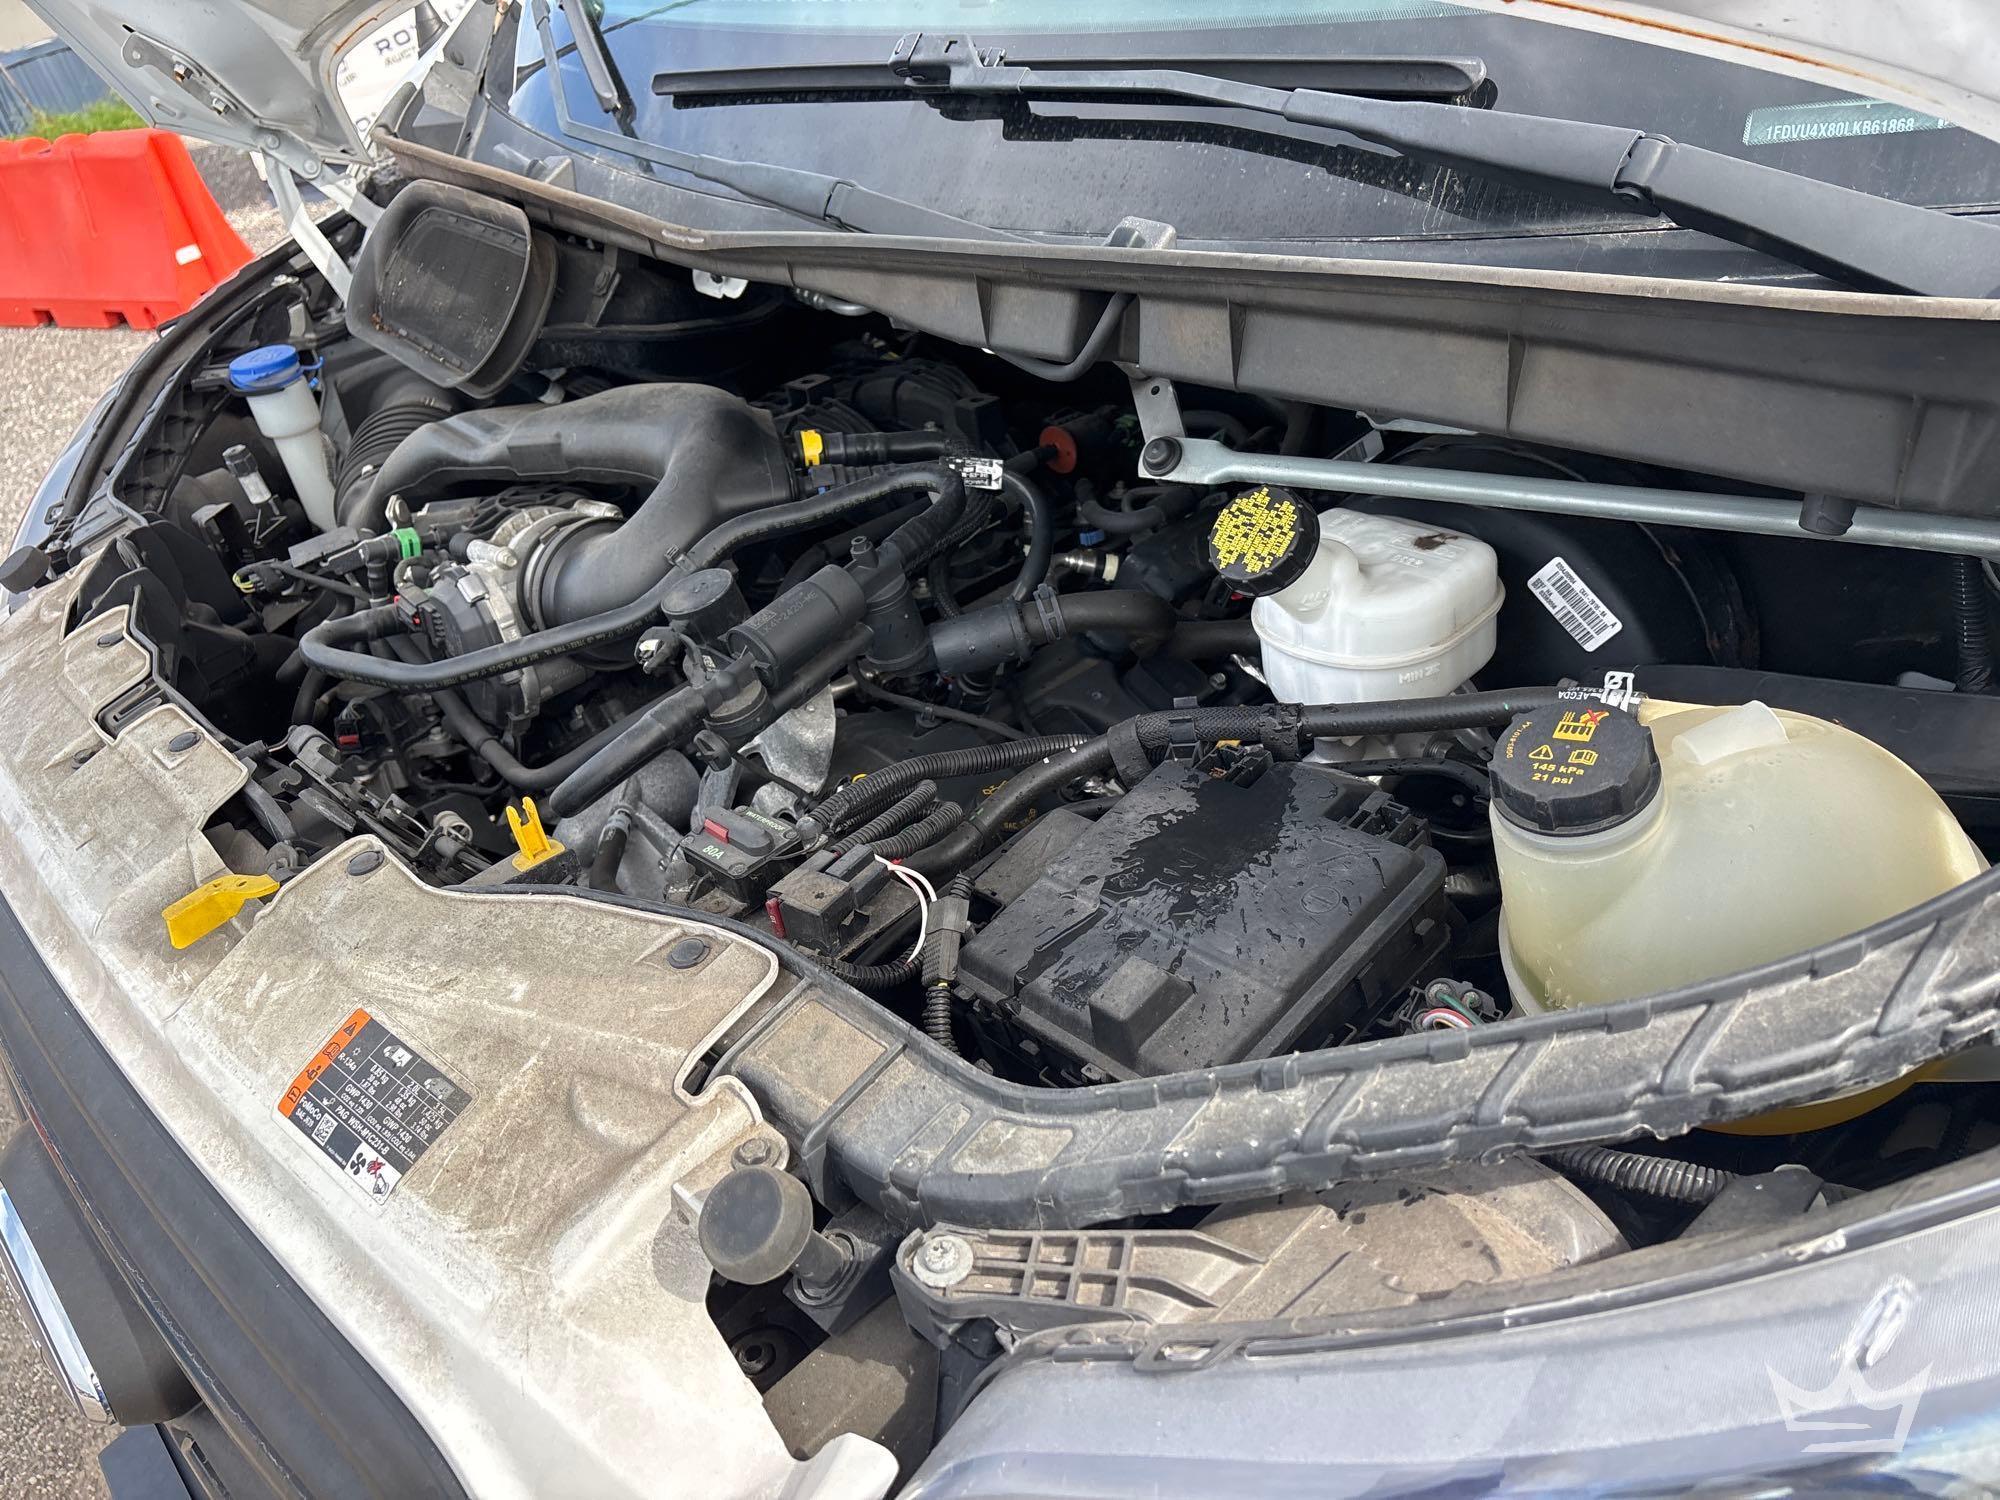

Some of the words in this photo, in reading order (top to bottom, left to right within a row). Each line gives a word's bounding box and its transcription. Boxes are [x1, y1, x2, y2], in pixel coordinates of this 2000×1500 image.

[1262, 555, 1273, 568] CAP
[1531, 773, 1549, 781] 21
[1532, 762, 1557, 772] 145
[1559, 766, 1585, 775] kPa
[745, 811, 786, 831] WATERPROOF
[702, 845, 725, 860] 80A
[337, 1052, 357, 1071] R-134a
[345, 1083, 361, 1097] GWP
[358, 1095, 373, 1109] 1430
[299, 1096, 321, 1120] FoMoCo
[432, 1102, 446, 1117] 3.5L
[334, 1105, 349, 1119] PAG
[348, 1116, 389, 1154] WSH-M1C231-B
[382, 1116, 399, 1130] GWP
[396, 1128, 412, 1143] 1430
